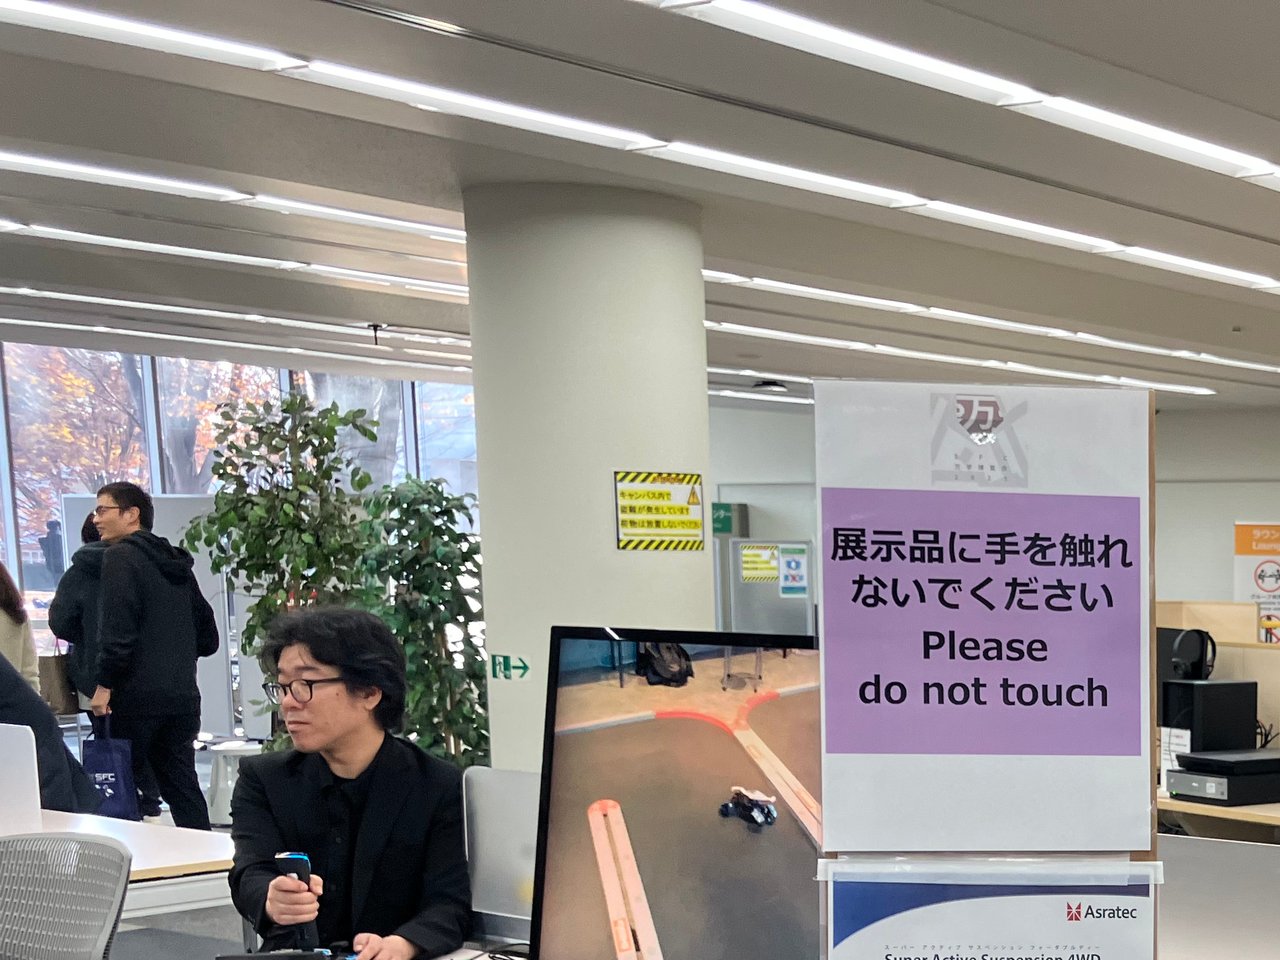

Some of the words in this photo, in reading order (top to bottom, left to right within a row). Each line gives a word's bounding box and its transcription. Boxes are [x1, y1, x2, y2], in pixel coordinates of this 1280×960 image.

[831, 527, 1133, 568] 展示品に手を触れ
[851, 574, 1114, 612] ないでください
[923, 630, 1048, 662] Please
[858, 674, 907, 704] do
[923, 677, 987, 705] not
[1000, 677, 1108, 707] touch
[1084, 905, 1137, 919] Asratec
